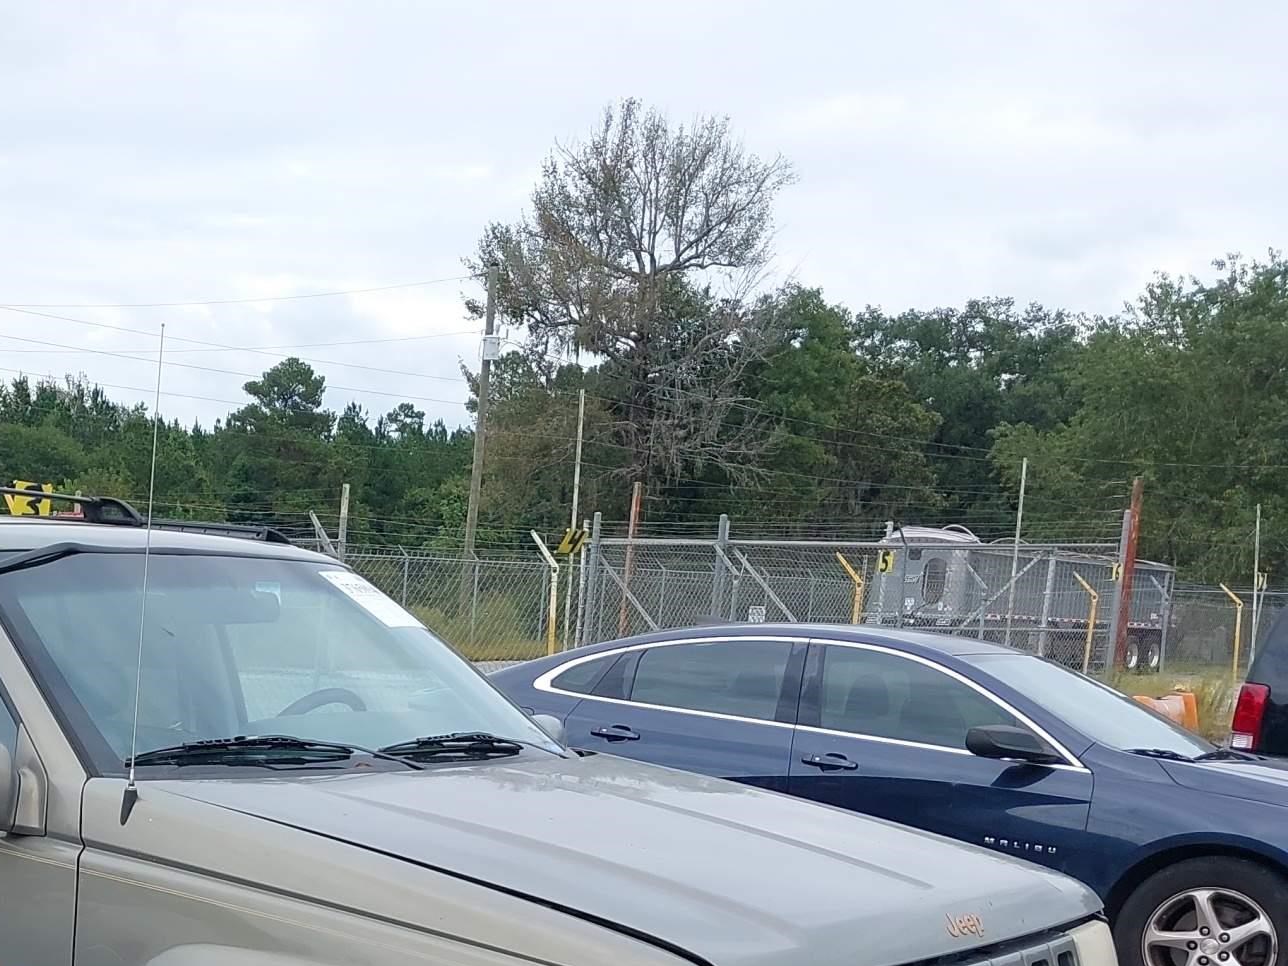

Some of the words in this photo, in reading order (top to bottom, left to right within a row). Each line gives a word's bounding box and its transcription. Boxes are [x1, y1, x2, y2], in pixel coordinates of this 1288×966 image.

[879, 550, 890, 573] 5
[984, 836, 1057, 854] MALIBU
[945, 912, 985, 938] Jeep
